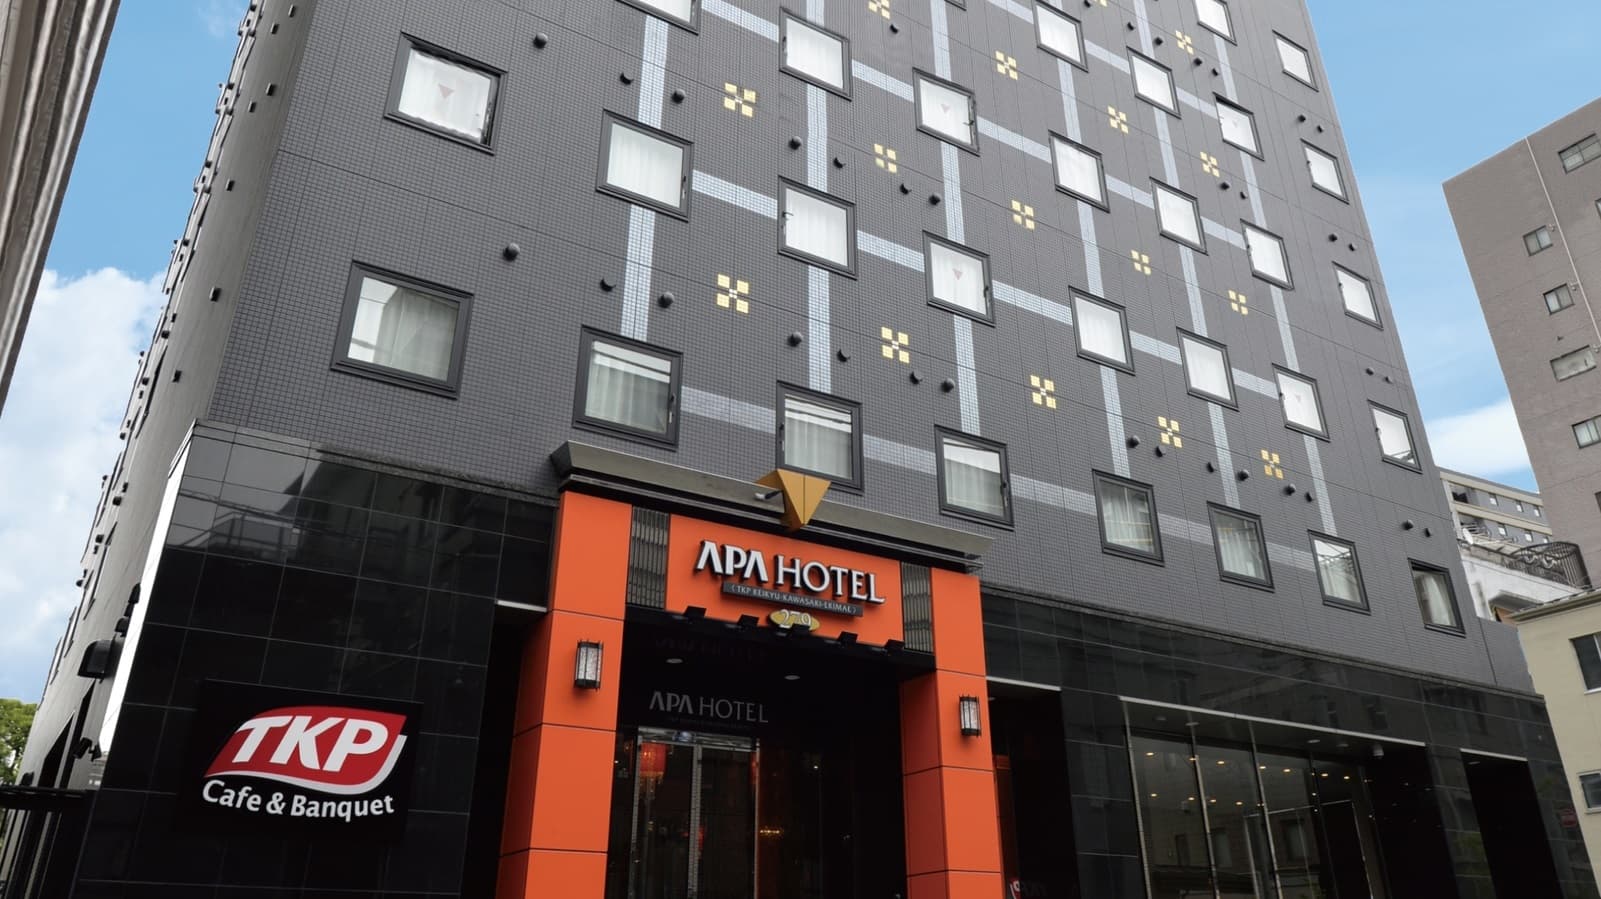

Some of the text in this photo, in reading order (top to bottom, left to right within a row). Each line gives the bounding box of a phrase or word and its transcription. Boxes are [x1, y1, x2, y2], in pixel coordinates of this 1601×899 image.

[696, 540, 885, 603] APA HOTEL
[649, 690, 769, 723] APA HOTEL
[232, 715, 389, 772] TKP
[202, 779, 395, 822] Cafe & Banquet
